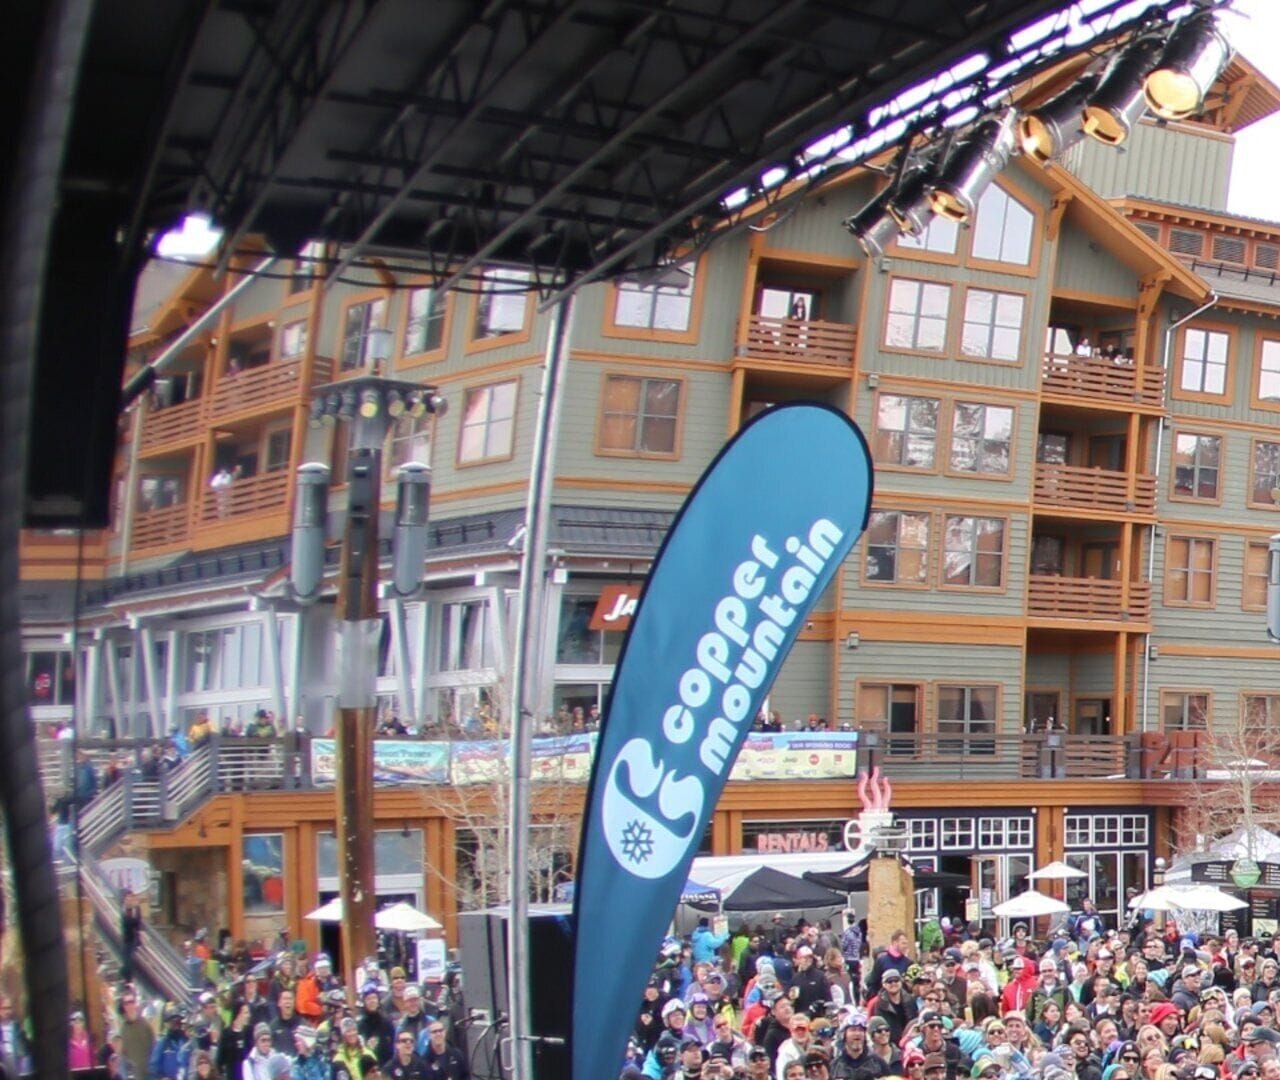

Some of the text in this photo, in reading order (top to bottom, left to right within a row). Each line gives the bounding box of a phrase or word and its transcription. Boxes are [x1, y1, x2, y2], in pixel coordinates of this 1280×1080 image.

[663, 534, 780, 744] copper
[699, 518, 843, 776] mountain
[757, 832, 828, 854] RENTALS
